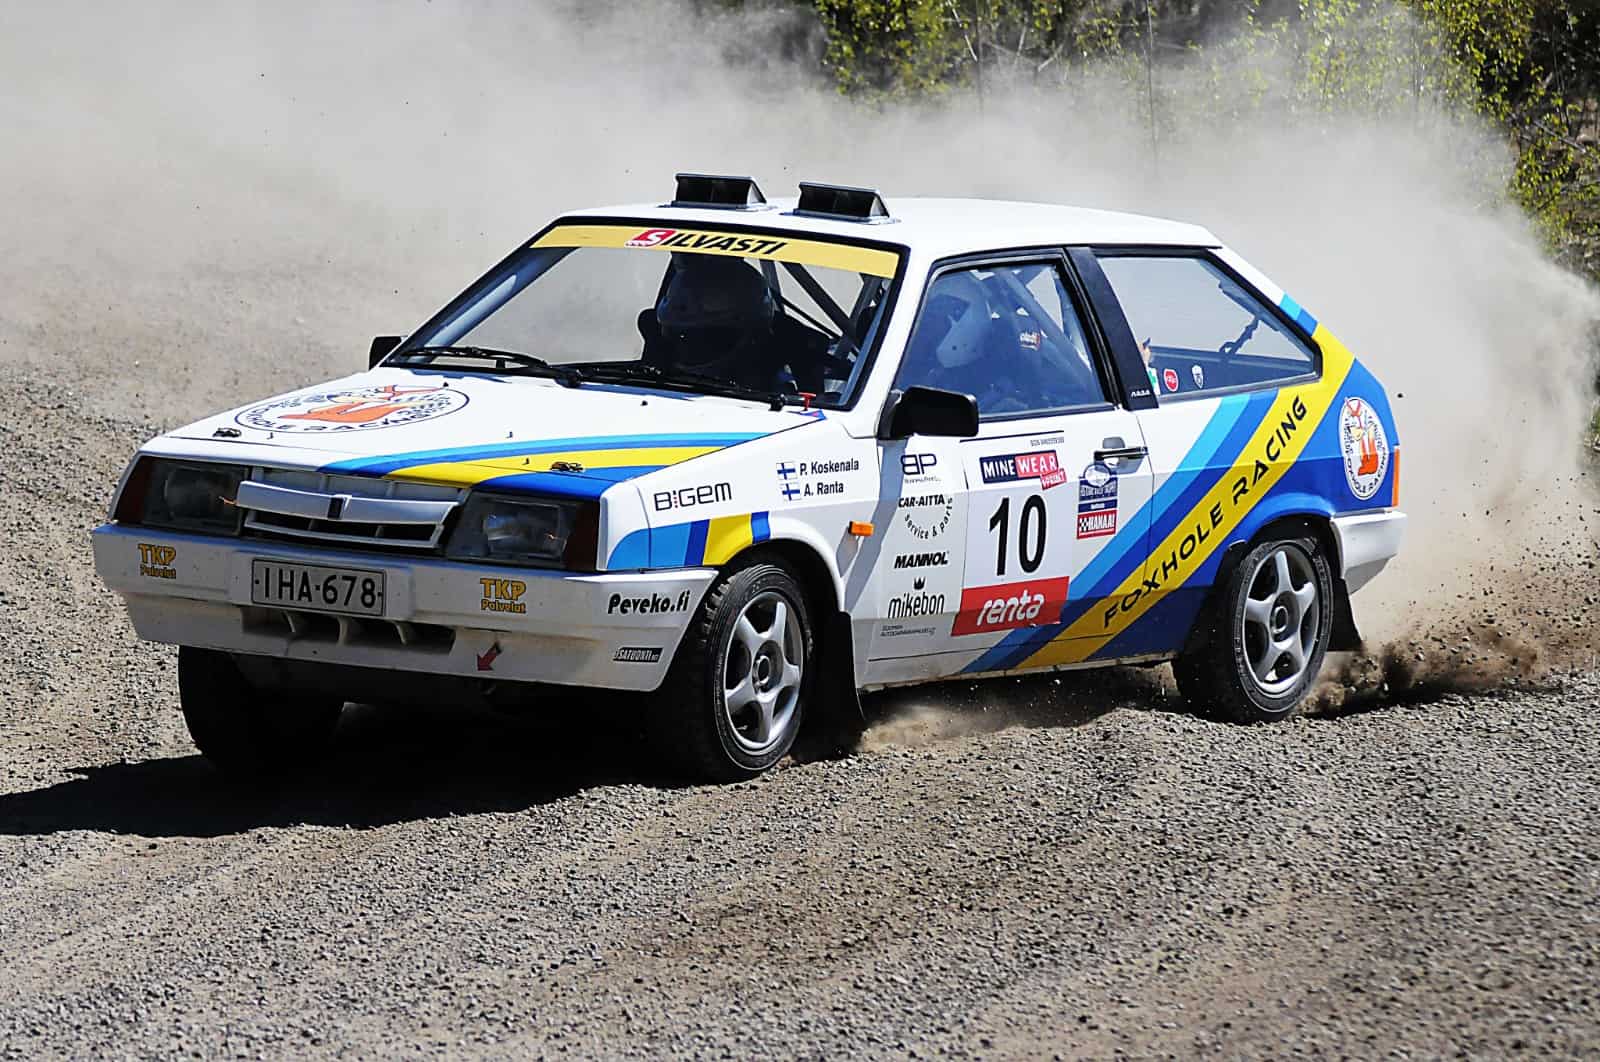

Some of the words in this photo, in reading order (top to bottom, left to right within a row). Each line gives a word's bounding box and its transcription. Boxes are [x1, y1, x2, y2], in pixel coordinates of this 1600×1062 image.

[800, 463, 808, 476] P.
[811, 458, 860, 474] Koskenala
[983, 461, 1016, 479] MINE
[1017, 455, 1058, 476] WEAR
[804, 484, 814, 497] A.
[817, 481, 844, 495] Ranta
[1104, 503, 1224, 628] FOXHOLE
[1232, 396, 1307, 505] RACING
[989, 494, 1047, 577] 10
[138, 544, 176, 565] TKP
[894, 552, 948, 569] MANNOL
[264, 567, 377, 609] IHA-678
[480, 578, 527, 601] TKP
[607, 589, 690, 615] Peveko.fi
[888, 592, 945, 619] mikebon
[976, 588, 1045, 626] renta
